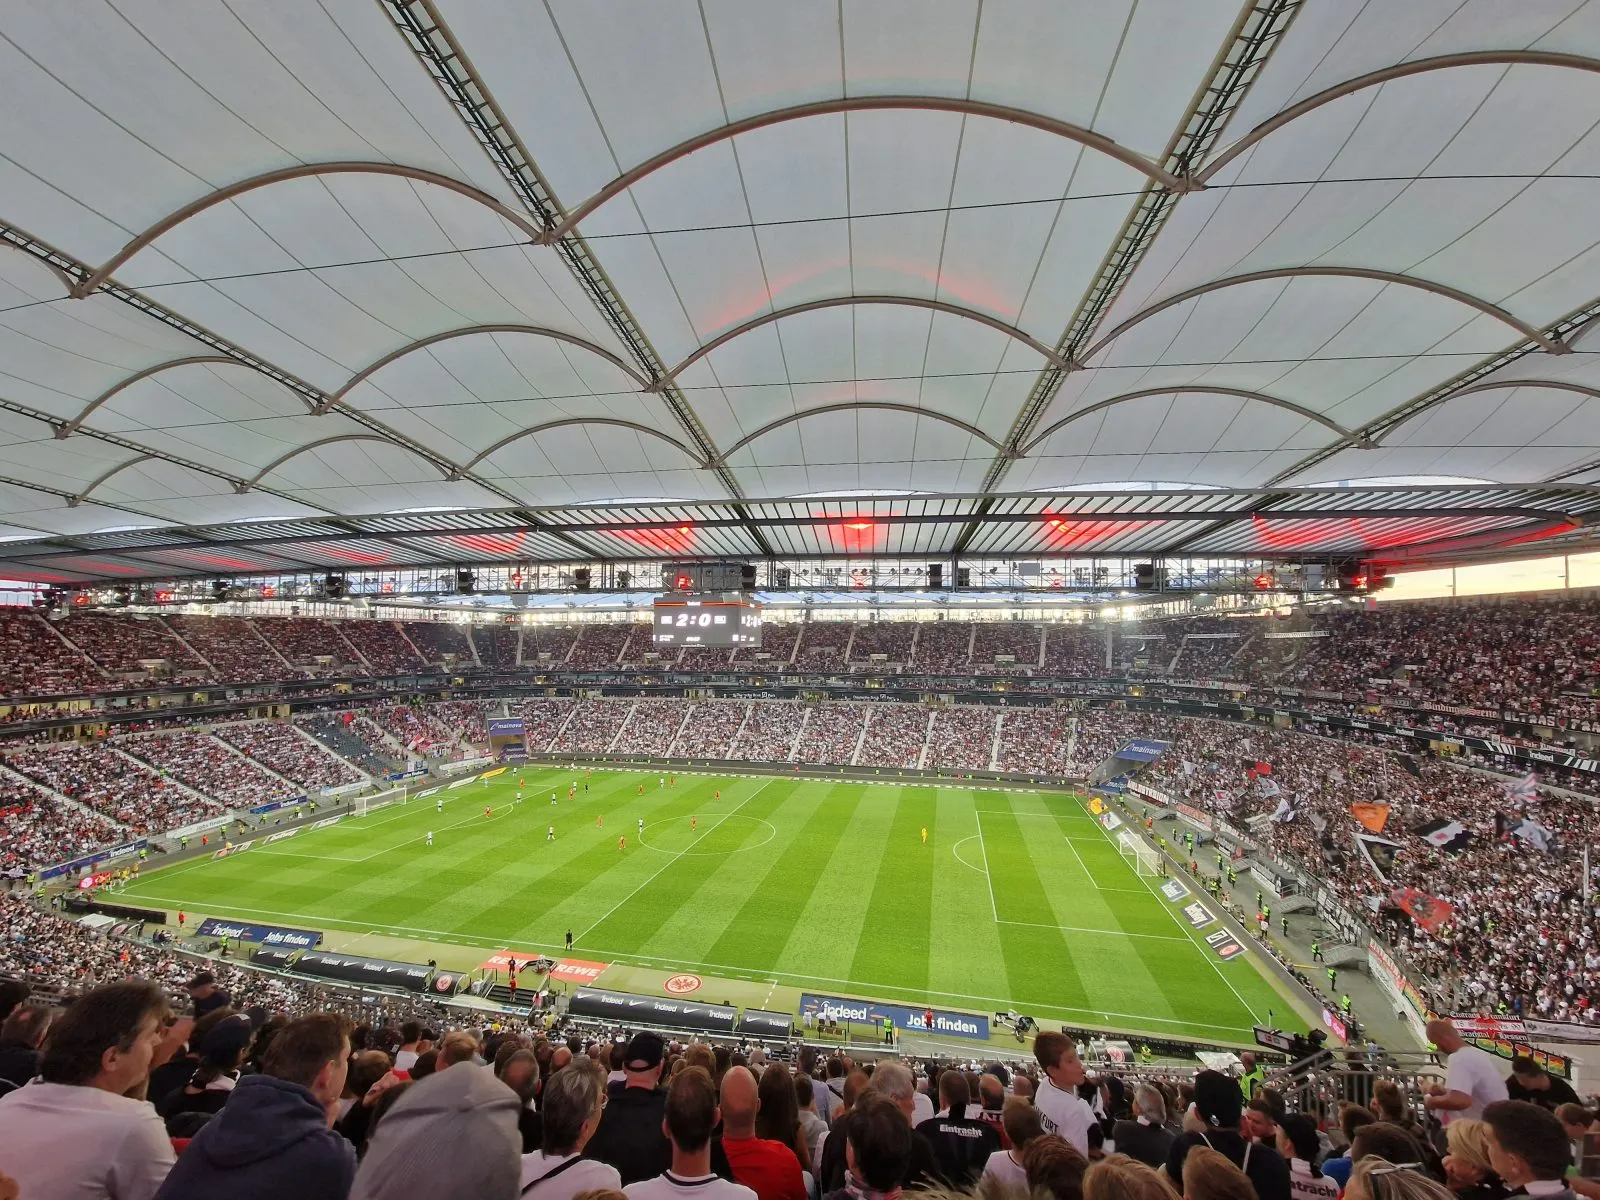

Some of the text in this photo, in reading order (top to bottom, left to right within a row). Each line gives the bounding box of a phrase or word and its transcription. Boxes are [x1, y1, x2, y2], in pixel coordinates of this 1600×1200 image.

[676, 613, 711, 627] 2:0
[1530, 749, 1554, 762] indeed
[211, 923, 311, 946] indeed Jobs finden
[555, 963, 600, 977] REWE
[821, 1001, 867, 1020] indeed
[936, 1017, 978, 1034] finden
[940, 1119, 983, 1137] Eintracht
